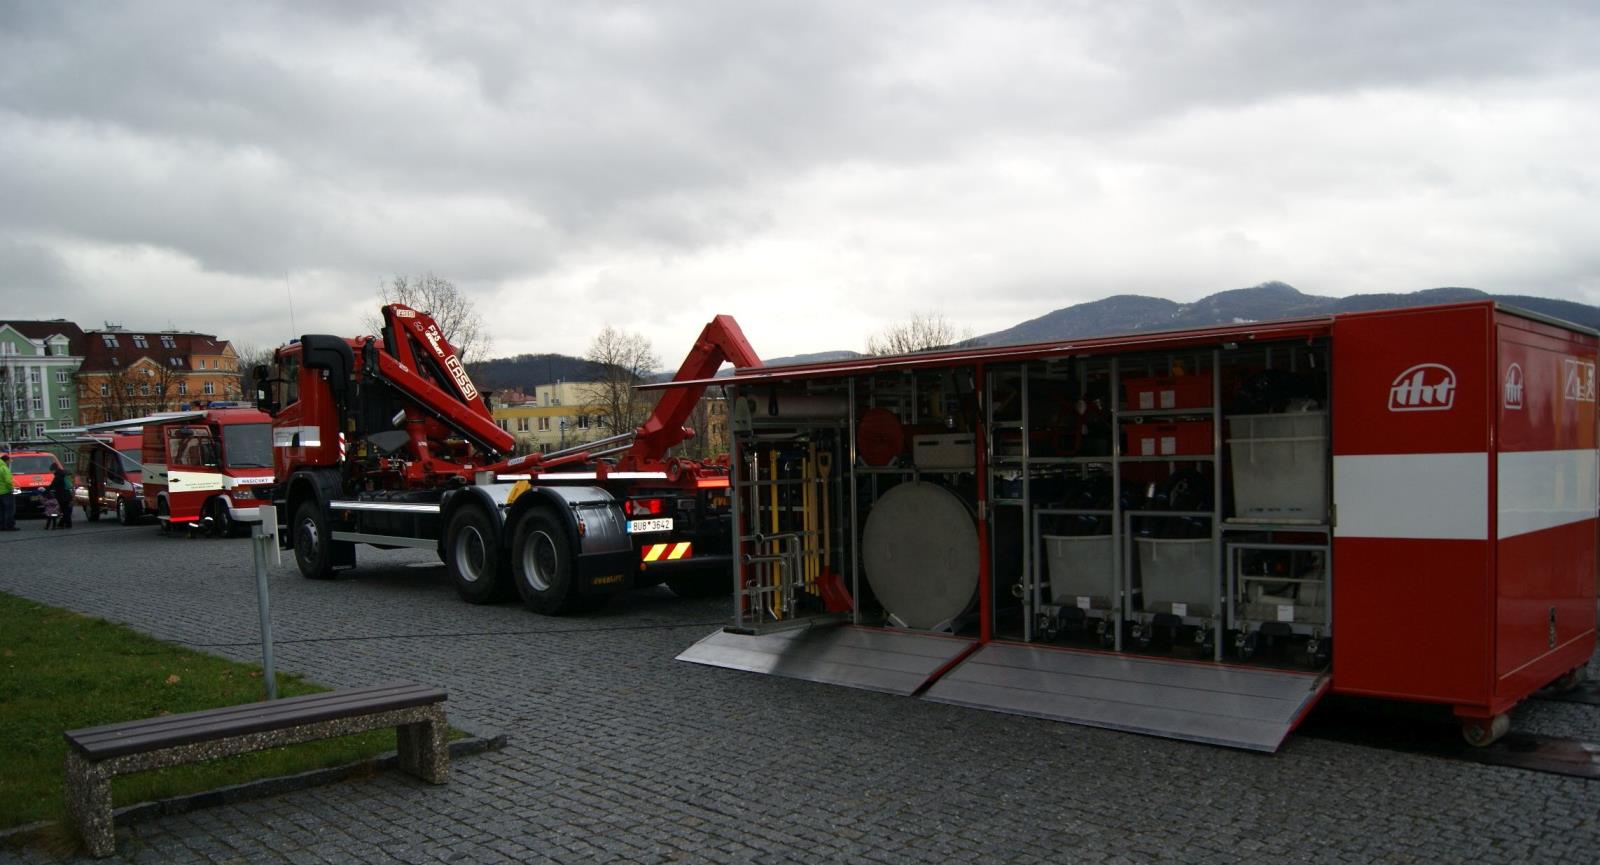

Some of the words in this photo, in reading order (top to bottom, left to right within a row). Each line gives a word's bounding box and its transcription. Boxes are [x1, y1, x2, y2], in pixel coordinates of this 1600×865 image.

[447, 357, 476, 398] FASSI
[633, 521, 647, 531] 8U8
[652, 519, 670, 530] 3642
